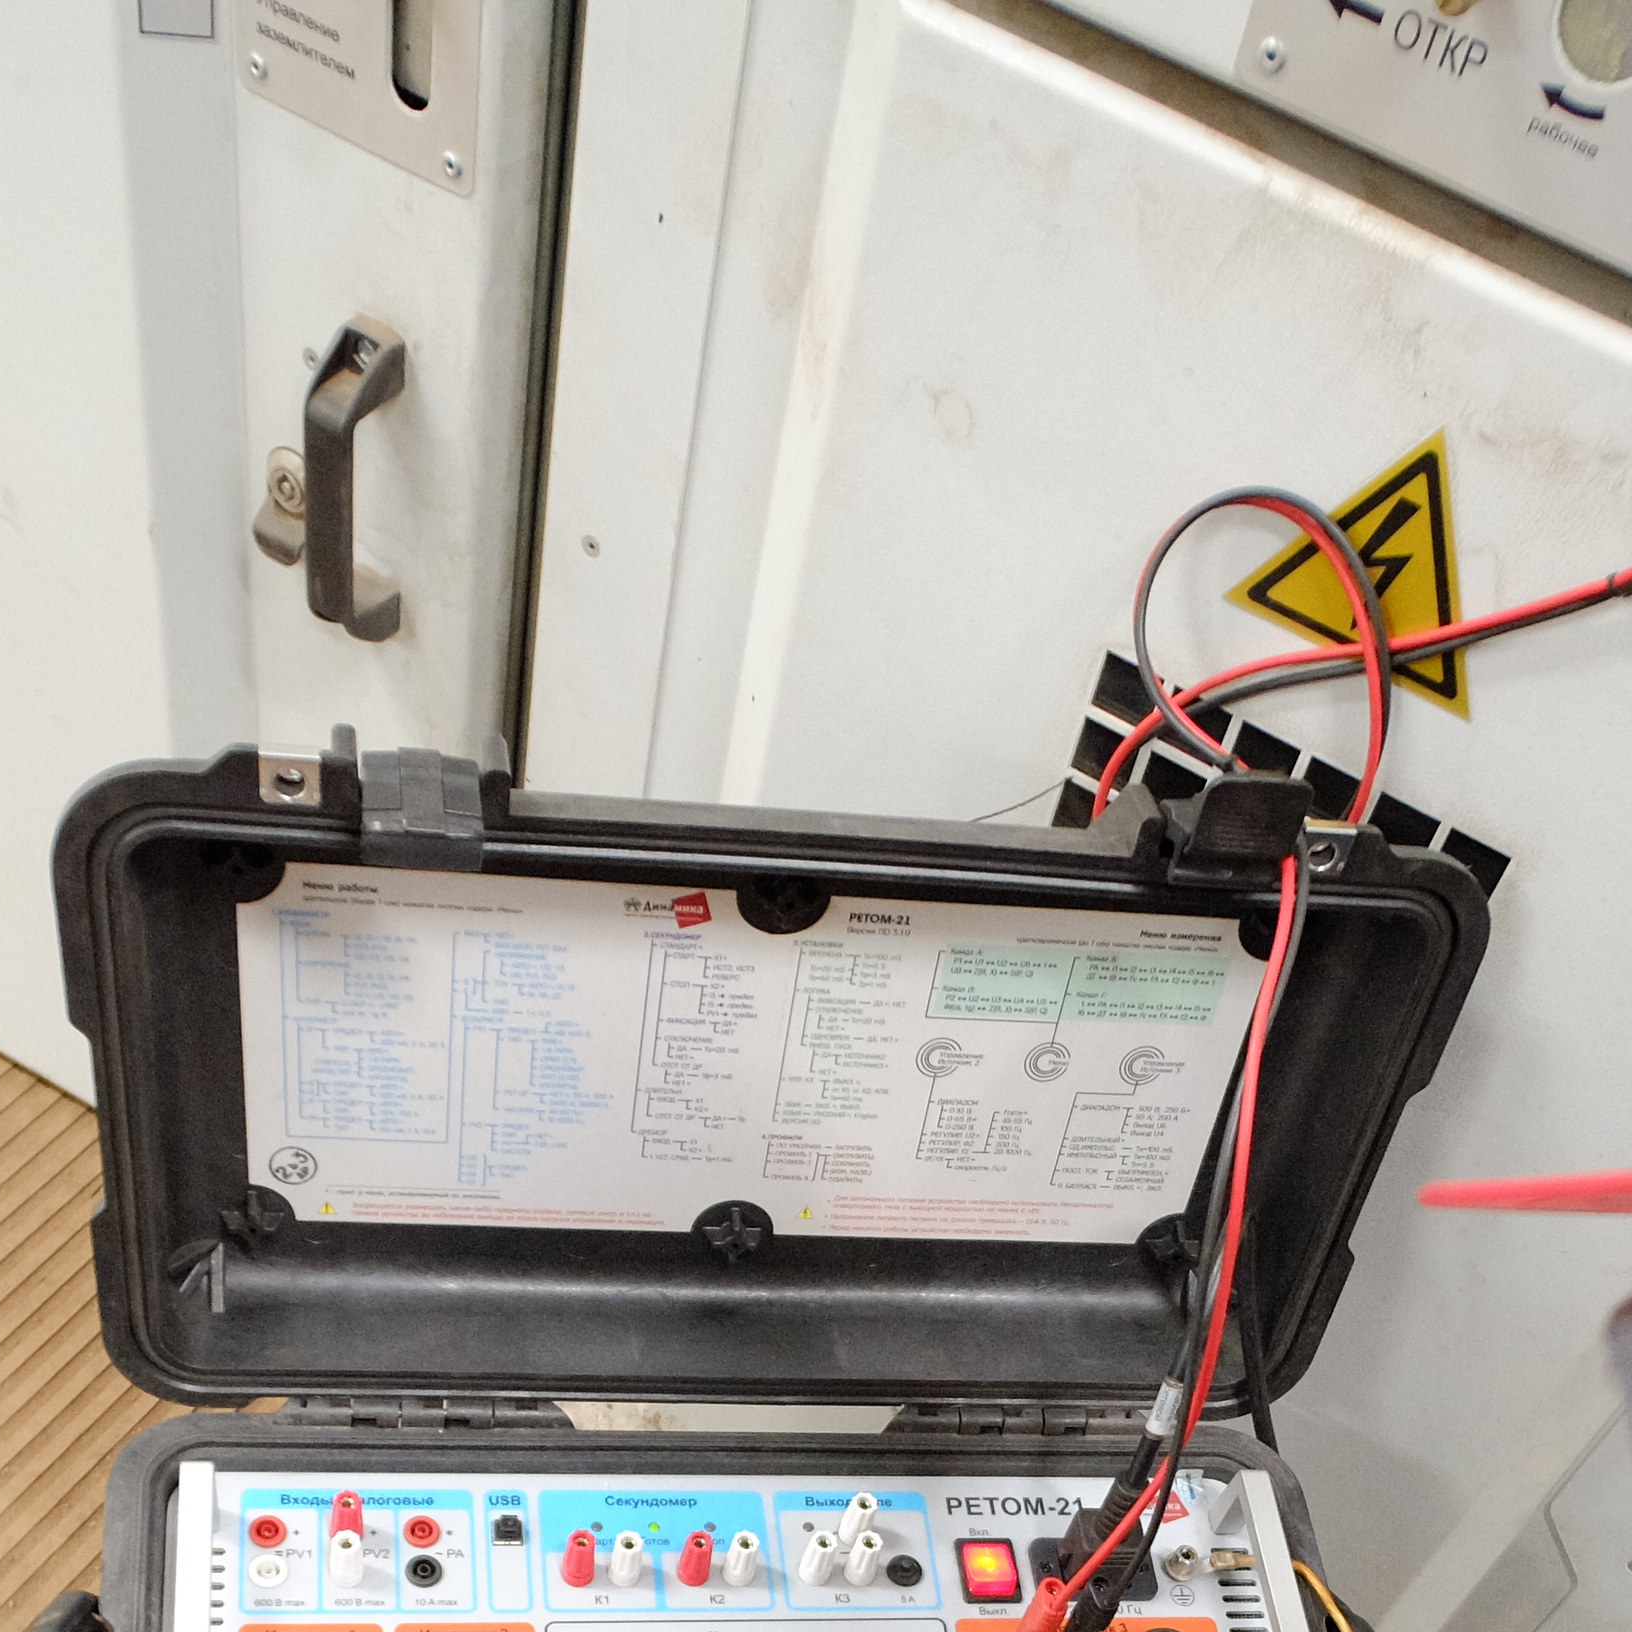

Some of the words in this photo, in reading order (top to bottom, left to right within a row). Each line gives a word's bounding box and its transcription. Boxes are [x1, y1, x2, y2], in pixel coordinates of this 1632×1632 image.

[256, 0, 340, 42] правление
[256, 21, 355, 79] заземлителем
[1393, 9, 1489, 80] ОТКР
[1526, 115, 1600, 159] рабочее
[643, 901, 704, 914] Динамика
[849, 912, 911, 926] РЕТОМ-21
[1139, 930, 1167, 941] Меню
[1170, 932, 1222, 944] измерения
[280, 1494, 334, 1507] Входы
[362, 1496, 434, 1507] логовые
[489, 1495, 521, 1506] USB
[605, 1495, 697, 1508] Секундомер
[946, 1497, 1083, 1516] РЕТОМ-21
[286, 1549, 312, 1559] PV1
[363, 1549, 390, 1559] PV2
[335, 1599, 353, 1607] 600
[1126, 1604, 1142, 1615] Гц
[979, 1606, 1009, 1616] Выкл.
